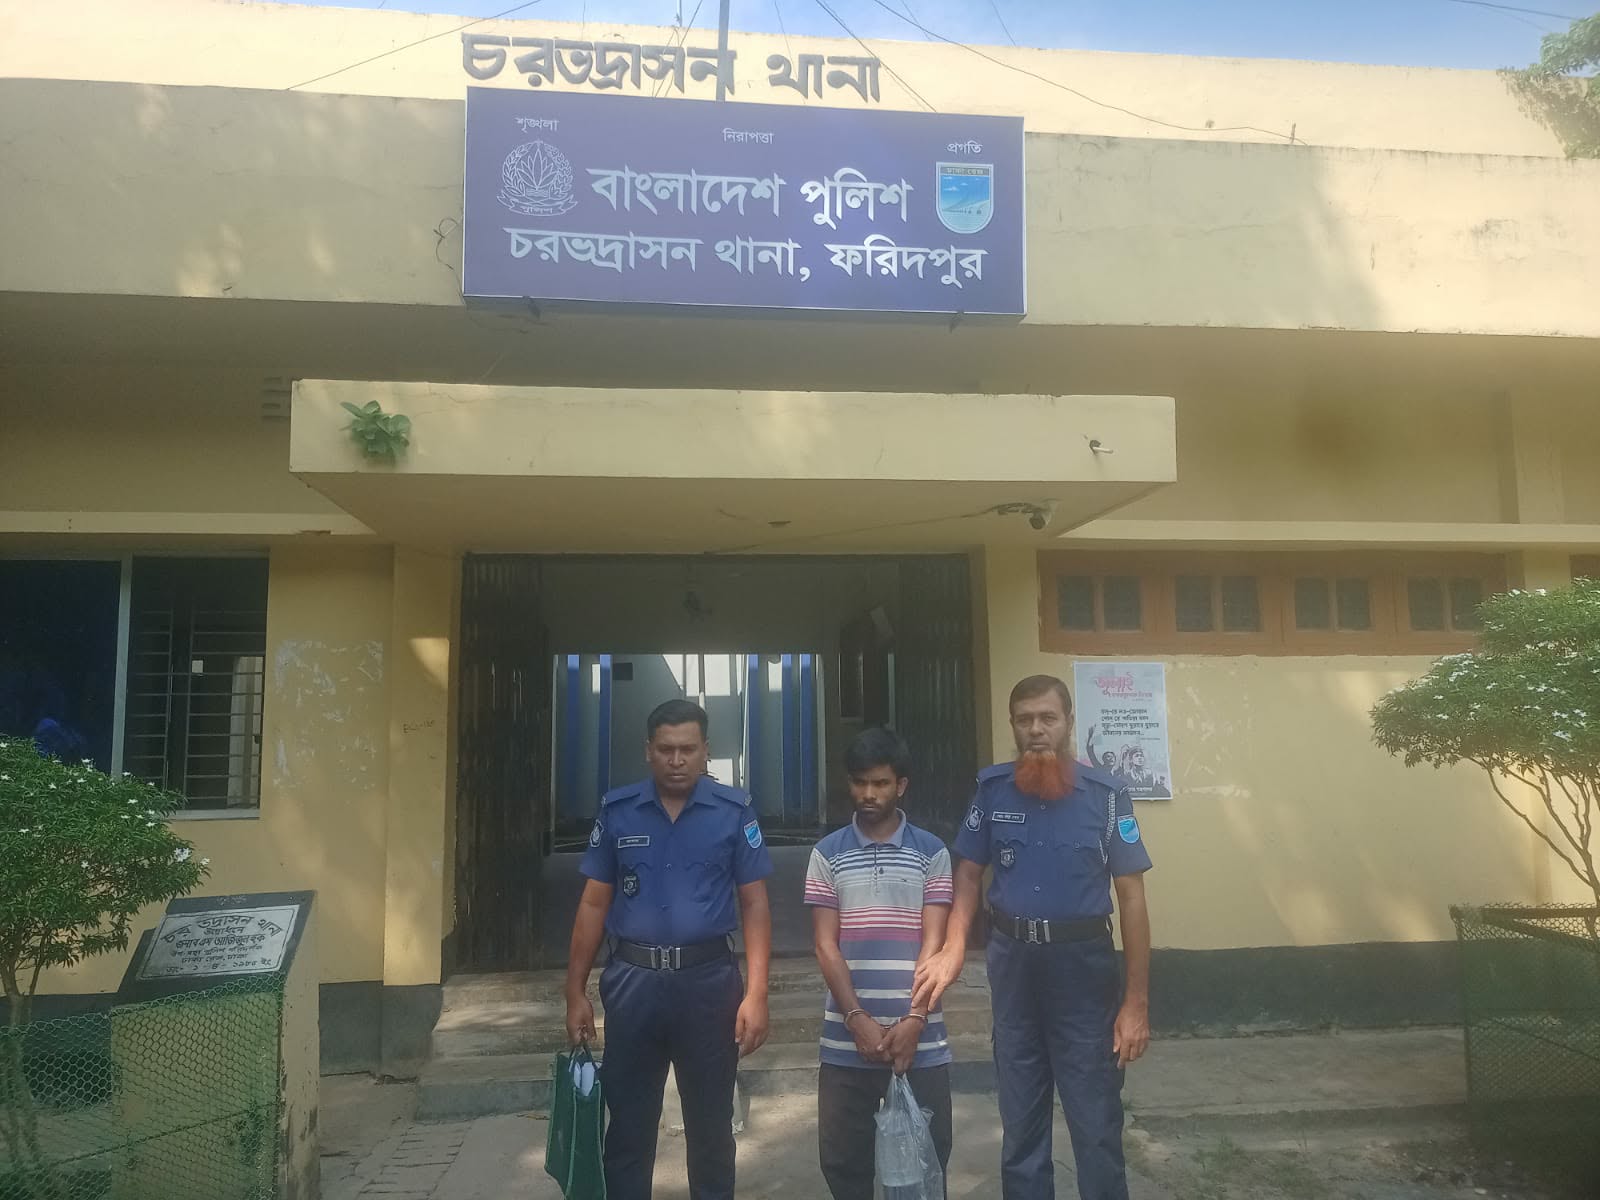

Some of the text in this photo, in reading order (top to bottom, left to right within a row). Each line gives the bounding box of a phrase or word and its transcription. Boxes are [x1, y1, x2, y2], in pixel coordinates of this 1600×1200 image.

[461, 32, 881, 103] চরভদ্রাসন থানা
[722, 127, 775, 144] নিরাপত্তা
[946, 140, 983, 154] প্রগতি
[586, 164, 913, 231] বাংলাদেশ পুলিশ
[503, 226, 989, 289] চরভদ্রাসন থানা, ফরিদপুর
[160, 915, 283, 943] চর ভদ্রাসন থানা
